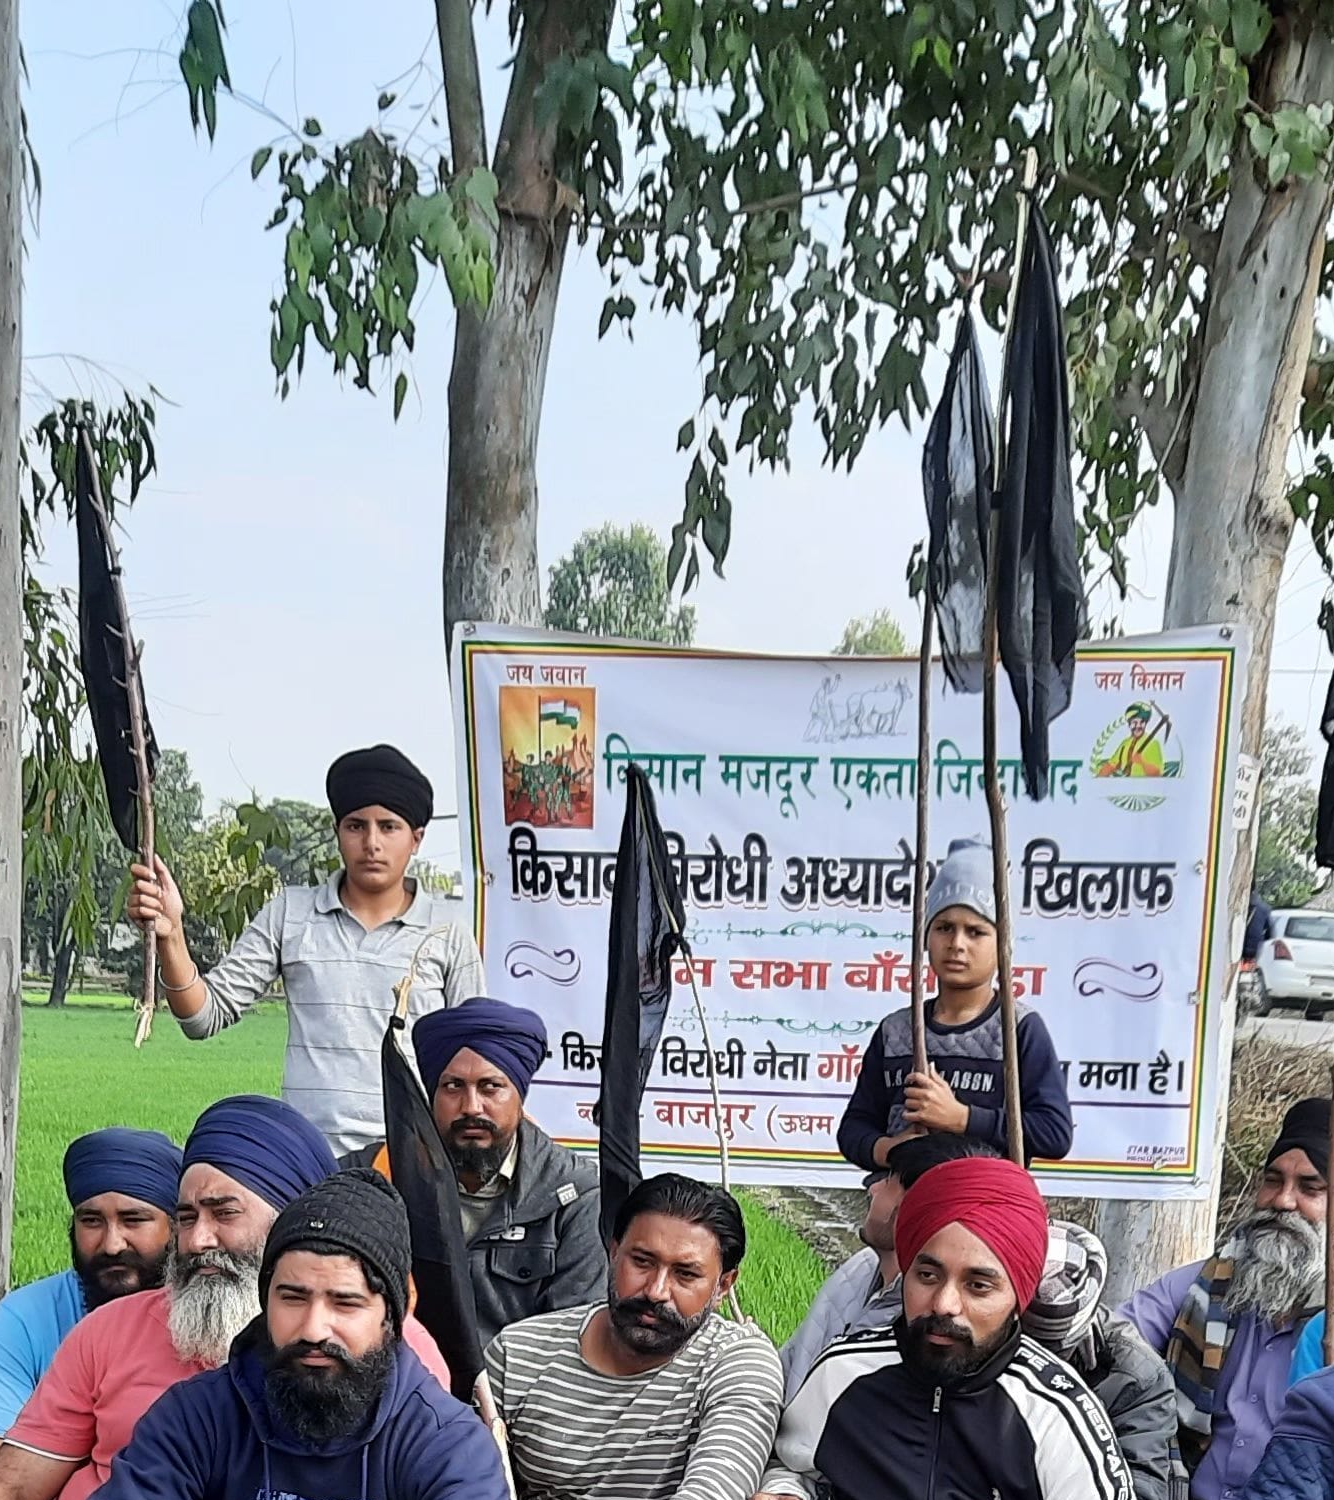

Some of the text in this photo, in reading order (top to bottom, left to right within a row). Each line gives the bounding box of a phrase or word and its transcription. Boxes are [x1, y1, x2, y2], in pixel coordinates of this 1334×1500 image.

[507, 664, 587, 686] जय जवान
[1094, 664, 1185, 692] जय किसान
[718, 754, 819, 819] मजदूर
[830, 756, 916, 811] एकता
[1021, 838, 1178, 914] खिलाफ
[728, 959, 832, 991] सभा
[753, 1039, 811, 1081] नेता
[1078, 1060, 1141, 1091] मना
[653, 1100, 757, 1141] बाजपुर
